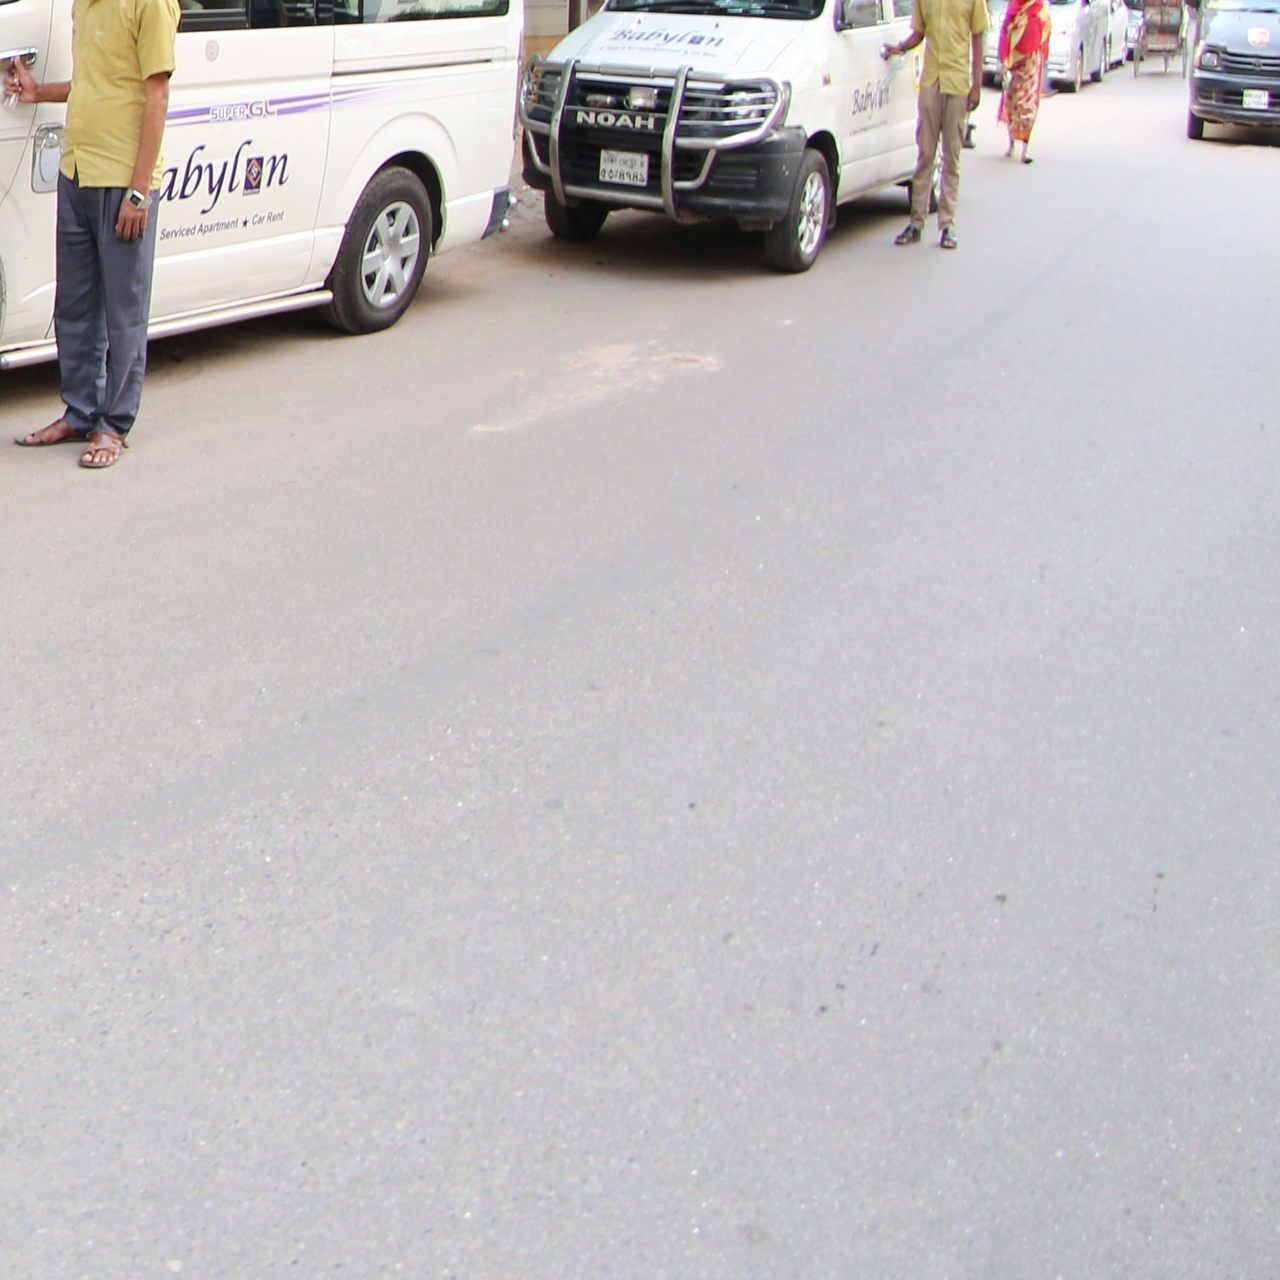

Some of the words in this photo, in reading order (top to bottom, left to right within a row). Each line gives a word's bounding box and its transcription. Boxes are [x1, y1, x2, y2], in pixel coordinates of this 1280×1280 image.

[210, 104, 246, 120] SUPER
[249, 100, 276, 118] GL
[576, 111, 655, 130] NOAH
[159, 140, 289, 215] abylon
[160, 224, 196, 240] Serviced
[197, 219, 239, 236] Apartment
[251, 213, 265, 225] Car
[266, 211, 284, 223] Rent
